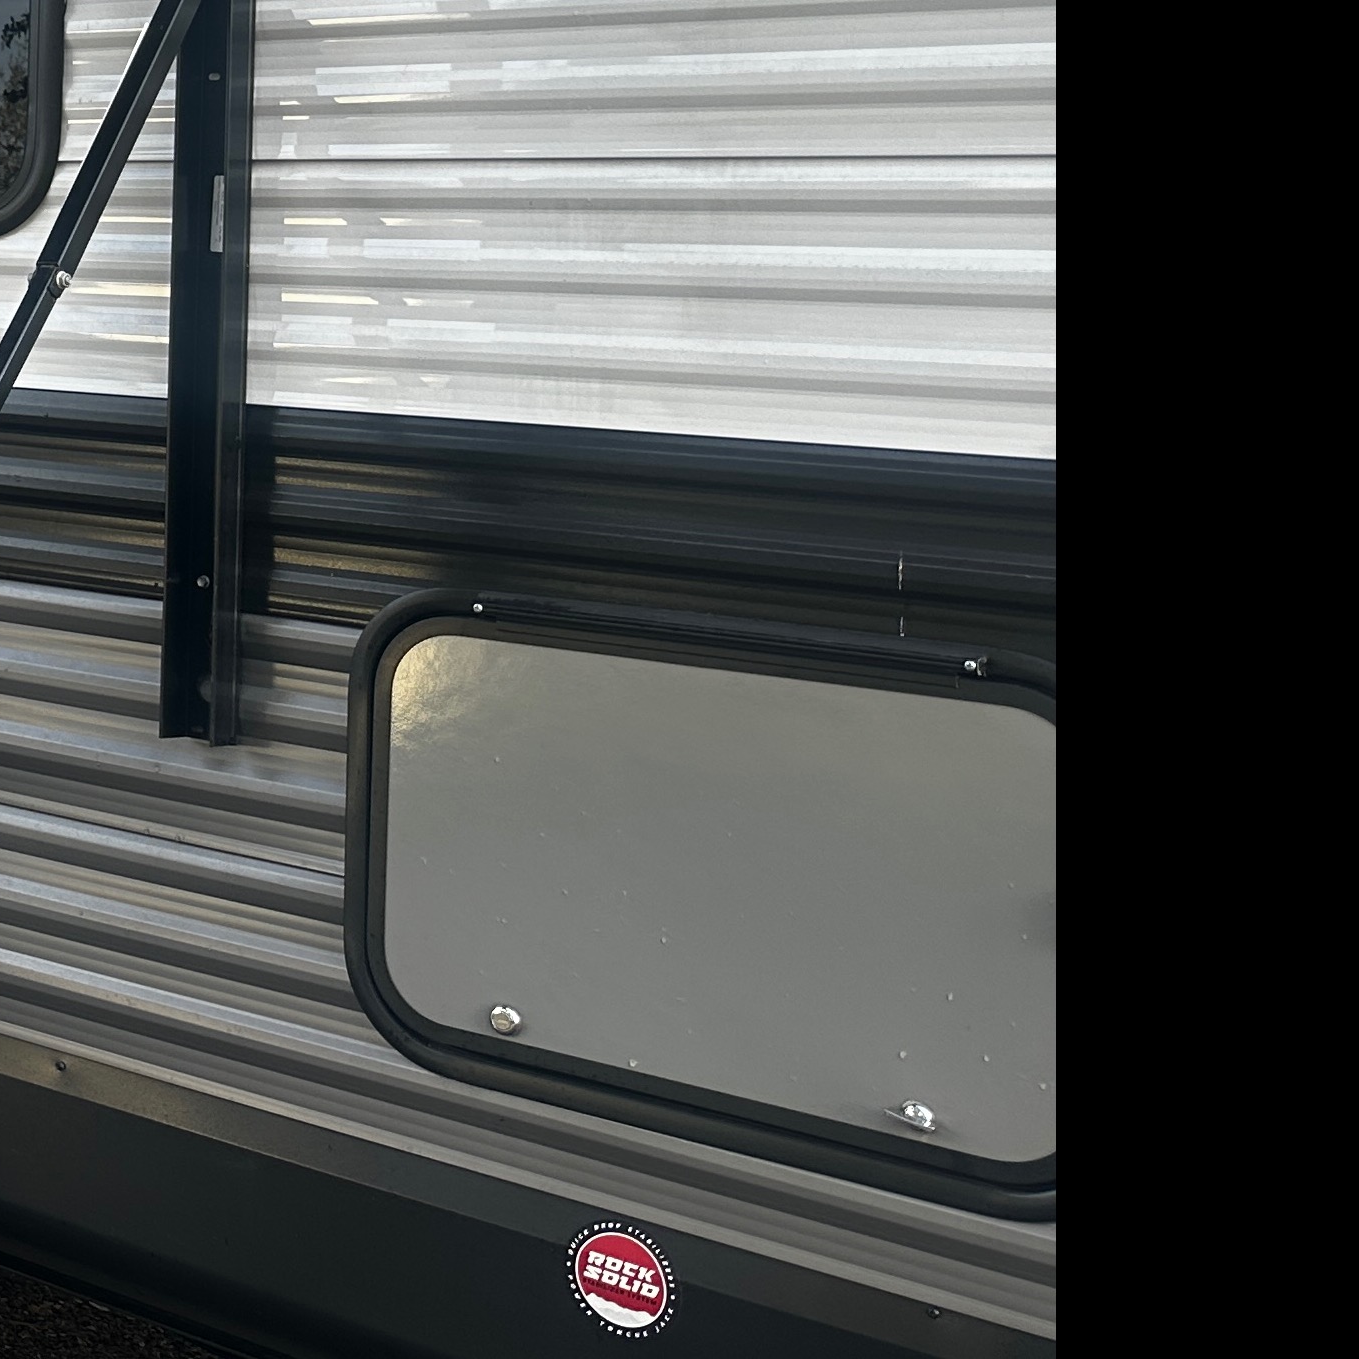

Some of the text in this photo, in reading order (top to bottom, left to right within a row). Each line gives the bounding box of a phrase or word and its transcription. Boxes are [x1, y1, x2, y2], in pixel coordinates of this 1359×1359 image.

[567, 1228, 589, 1255] QUICK
[593, 1222, 622, 1231] DROP
[583, 1265, 660, 1299] SOLID
[587, 1250, 656, 1283] ROCK
[599, 1320, 648, 1338] TONGUE
[655, 1307, 674, 1334] JACK
